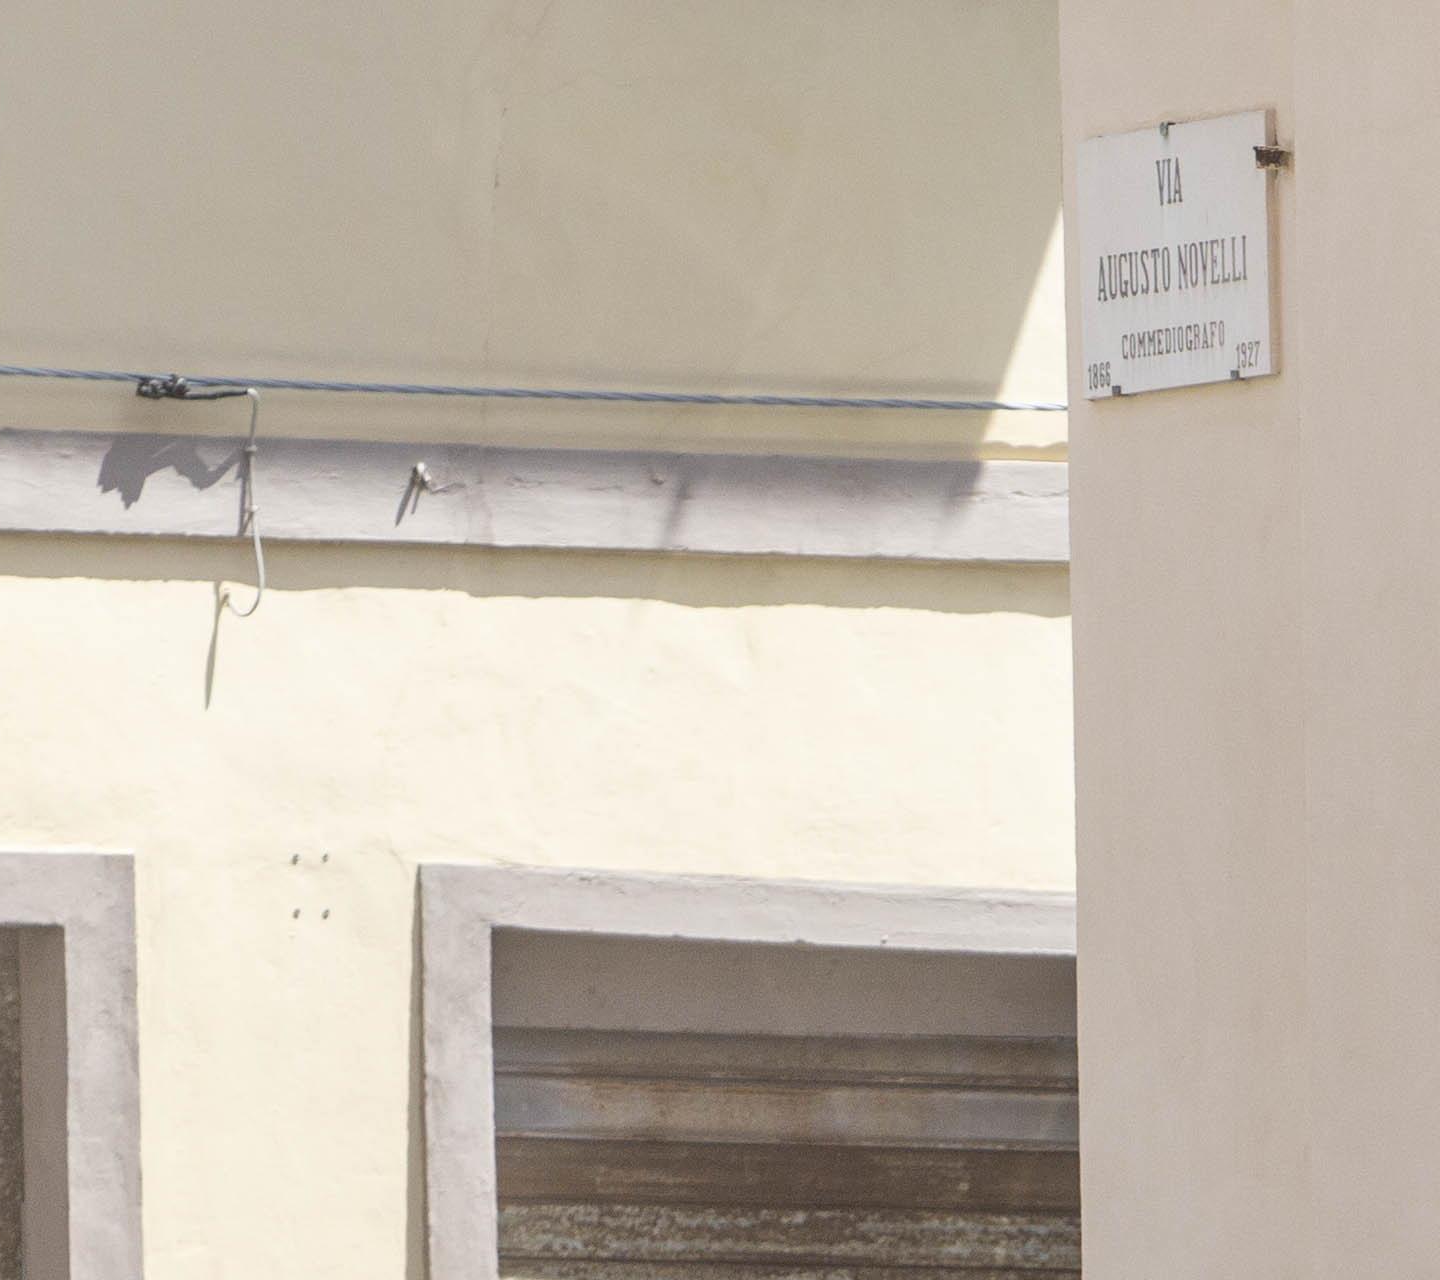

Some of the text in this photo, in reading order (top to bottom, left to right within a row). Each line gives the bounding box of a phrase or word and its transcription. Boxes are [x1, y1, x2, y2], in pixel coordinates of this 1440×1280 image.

[1155, 157, 1183, 206] VIA
[1097, 235, 1248, 302] AUGUSTO NOVELLI
[1121, 320, 1225, 360] COMMEDIOGRAFO
[1235, 340, 1260, 369] 1927
